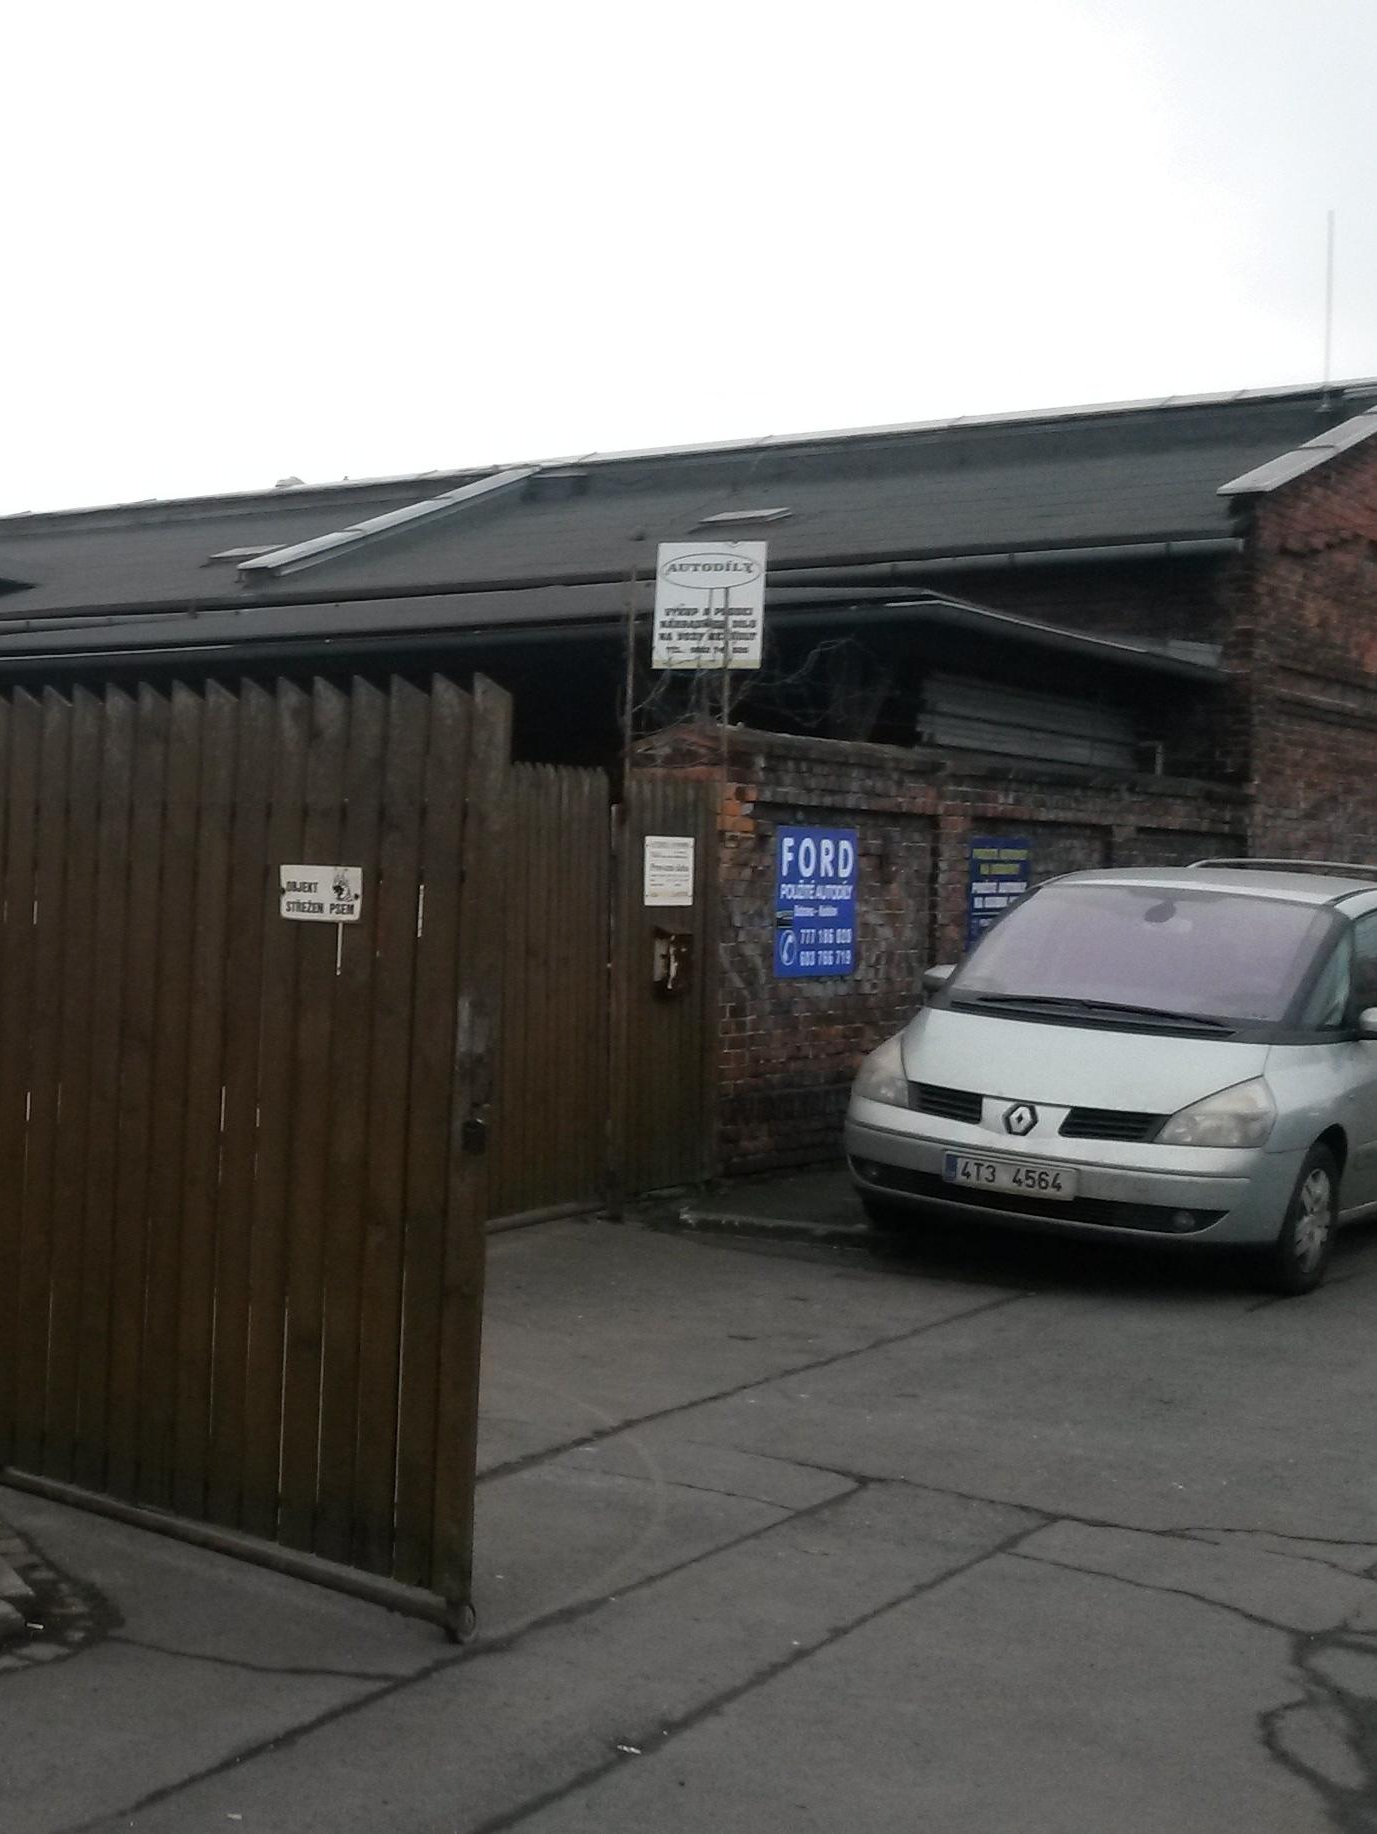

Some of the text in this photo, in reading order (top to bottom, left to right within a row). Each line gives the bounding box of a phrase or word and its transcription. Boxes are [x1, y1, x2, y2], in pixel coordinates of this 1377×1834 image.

[665, 560, 754, 574] AUTODÍLY
[780, 837, 854, 878] FORD
[286, 881, 319, 893] OBJEKT
[285, 899, 355, 915] STŘEŽEN PSEM
[800, 928, 816, 944] 777
[960, 1161, 1063, 1192] 4T3 4564
